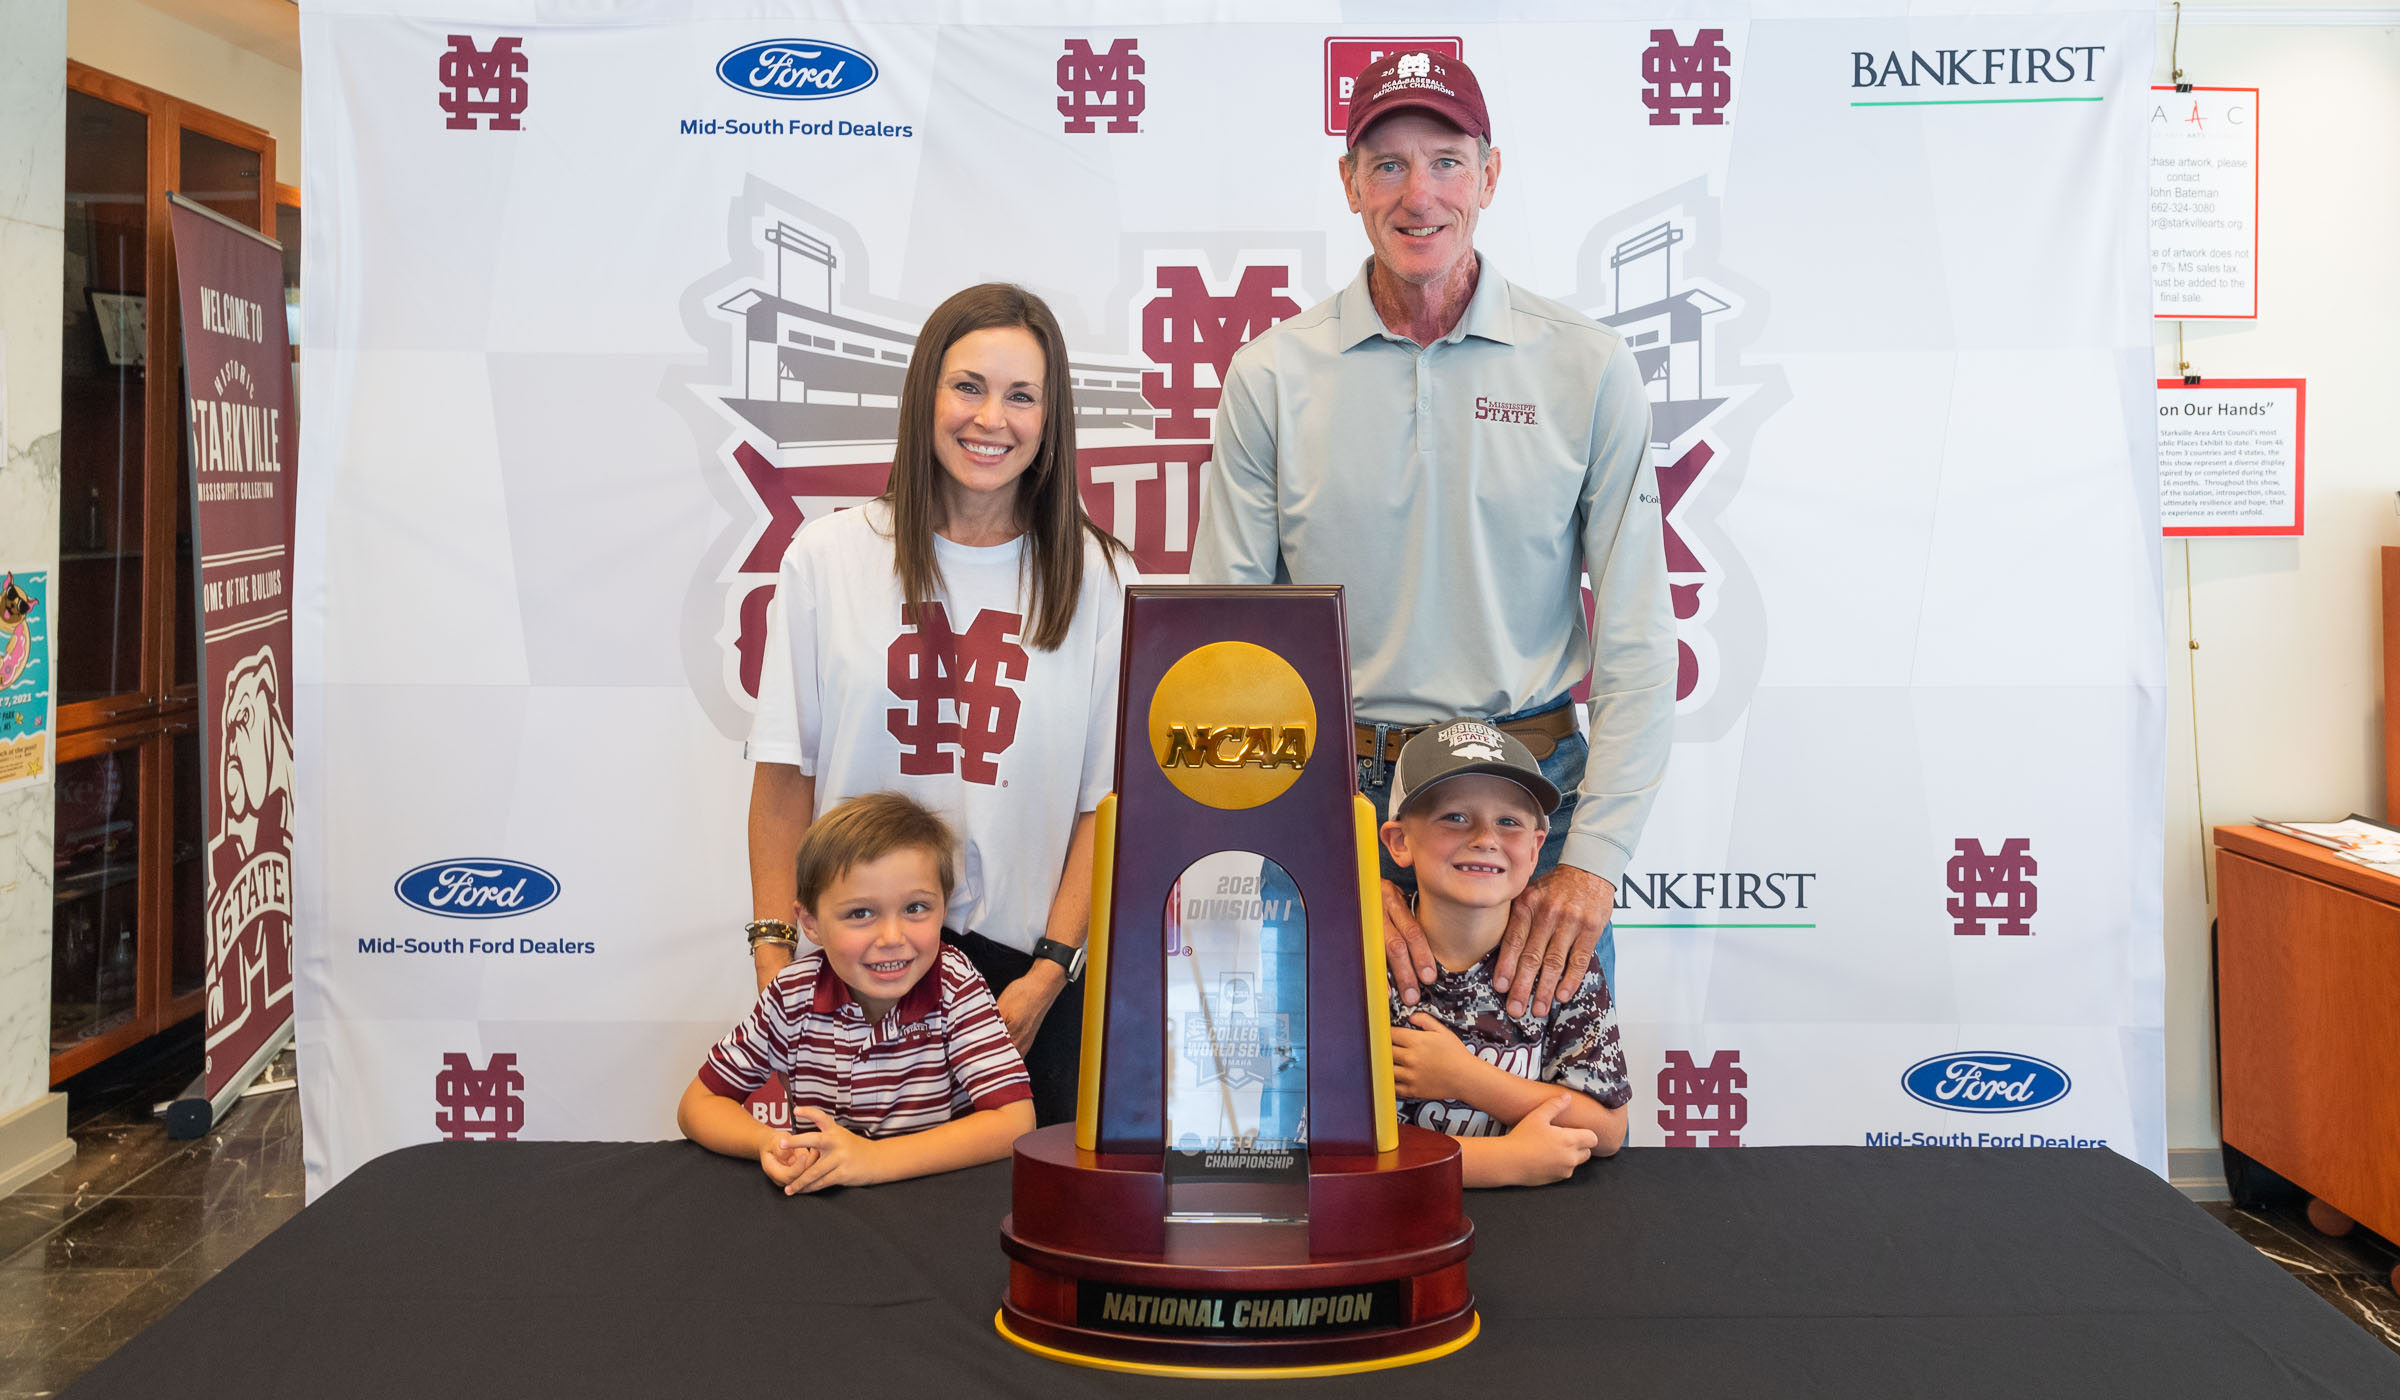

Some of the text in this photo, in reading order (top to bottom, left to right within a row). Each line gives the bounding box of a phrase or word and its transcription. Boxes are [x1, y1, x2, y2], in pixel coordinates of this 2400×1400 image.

[749, 47, 845, 91] Ford
[1434, 65, 1446, 76] 21
[1851, 46, 2105, 88] BANKFIRST
[1372, 83, 1408, 101] NATIONAL
[1410, 82, 1455, 97] CHAMPIONS
[680, 119, 913, 138] Mid-South Ford Dealers
[2217, 159, 2248, 169] please
[2167, 172, 2200, 182] contact
[2175, 187, 2219, 199] Bateman
[2151, 202, 2216, 213] 662-324-3080
[2162, 247, 2171, 258] of
[2173, 248, 2207, 258] artwork
[2209, 248, 2232, 258] does
[2235, 248, 2249, 259] not
[2178, 263, 2194, 273] MS
[2196, 264, 2221, 273] sales
[2173, 277, 2186, 288] be
[2188, 277, 2217, 288] added
[2220, 278, 2228, 288] to
[2231, 278, 2245, 288] the
[2160, 292, 2180, 302] final
[201, 285, 263, 344] WELCOME TO
[214, 359, 255, 400] HISTORIC
[1475, 397, 1537, 425] STATE
[1488, 401, 1536, 411] MISSISSIPPI
[2159, 405, 2179, 416] on
[2184, 403, 2213, 416] Our
[2168, 510, 2205, 518] experience
[204, 581, 224, 613] OME
[226, 579, 234, 608] OF
[235, 575, 249, 606] THE
[12, 692, 32, 705] 2021
[1438, 722, 1505, 743] MISSISSIPPI
[1456, 733, 1490, 744] STATE
[1161, 723, 1310, 770] NCAA
[428, 866, 527, 907] Ford
[1216, 876, 1261, 895] 2021
[1613, 873, 1816, 910] NKFIRST
[221, 858, 285, 945] STATE
[1187, 899, 1292, 921] DIVISION I
[358, 937, 596, 954] Mid-South Ford Dealers
[1187, 1042, 1236, 1057] WORLD
[1936, 1060, 2036, 1102] Ford
[1205, 1136, 1290, 1155] BASEBALL
[1865, 1132, 2107, 1149] Mid-South Ford Dealers
[1205, 1155, 1295, 1169] CHAMPIONSHIP
[1102, 1291, 1373, 1329] NATIONAL CHAMPION
